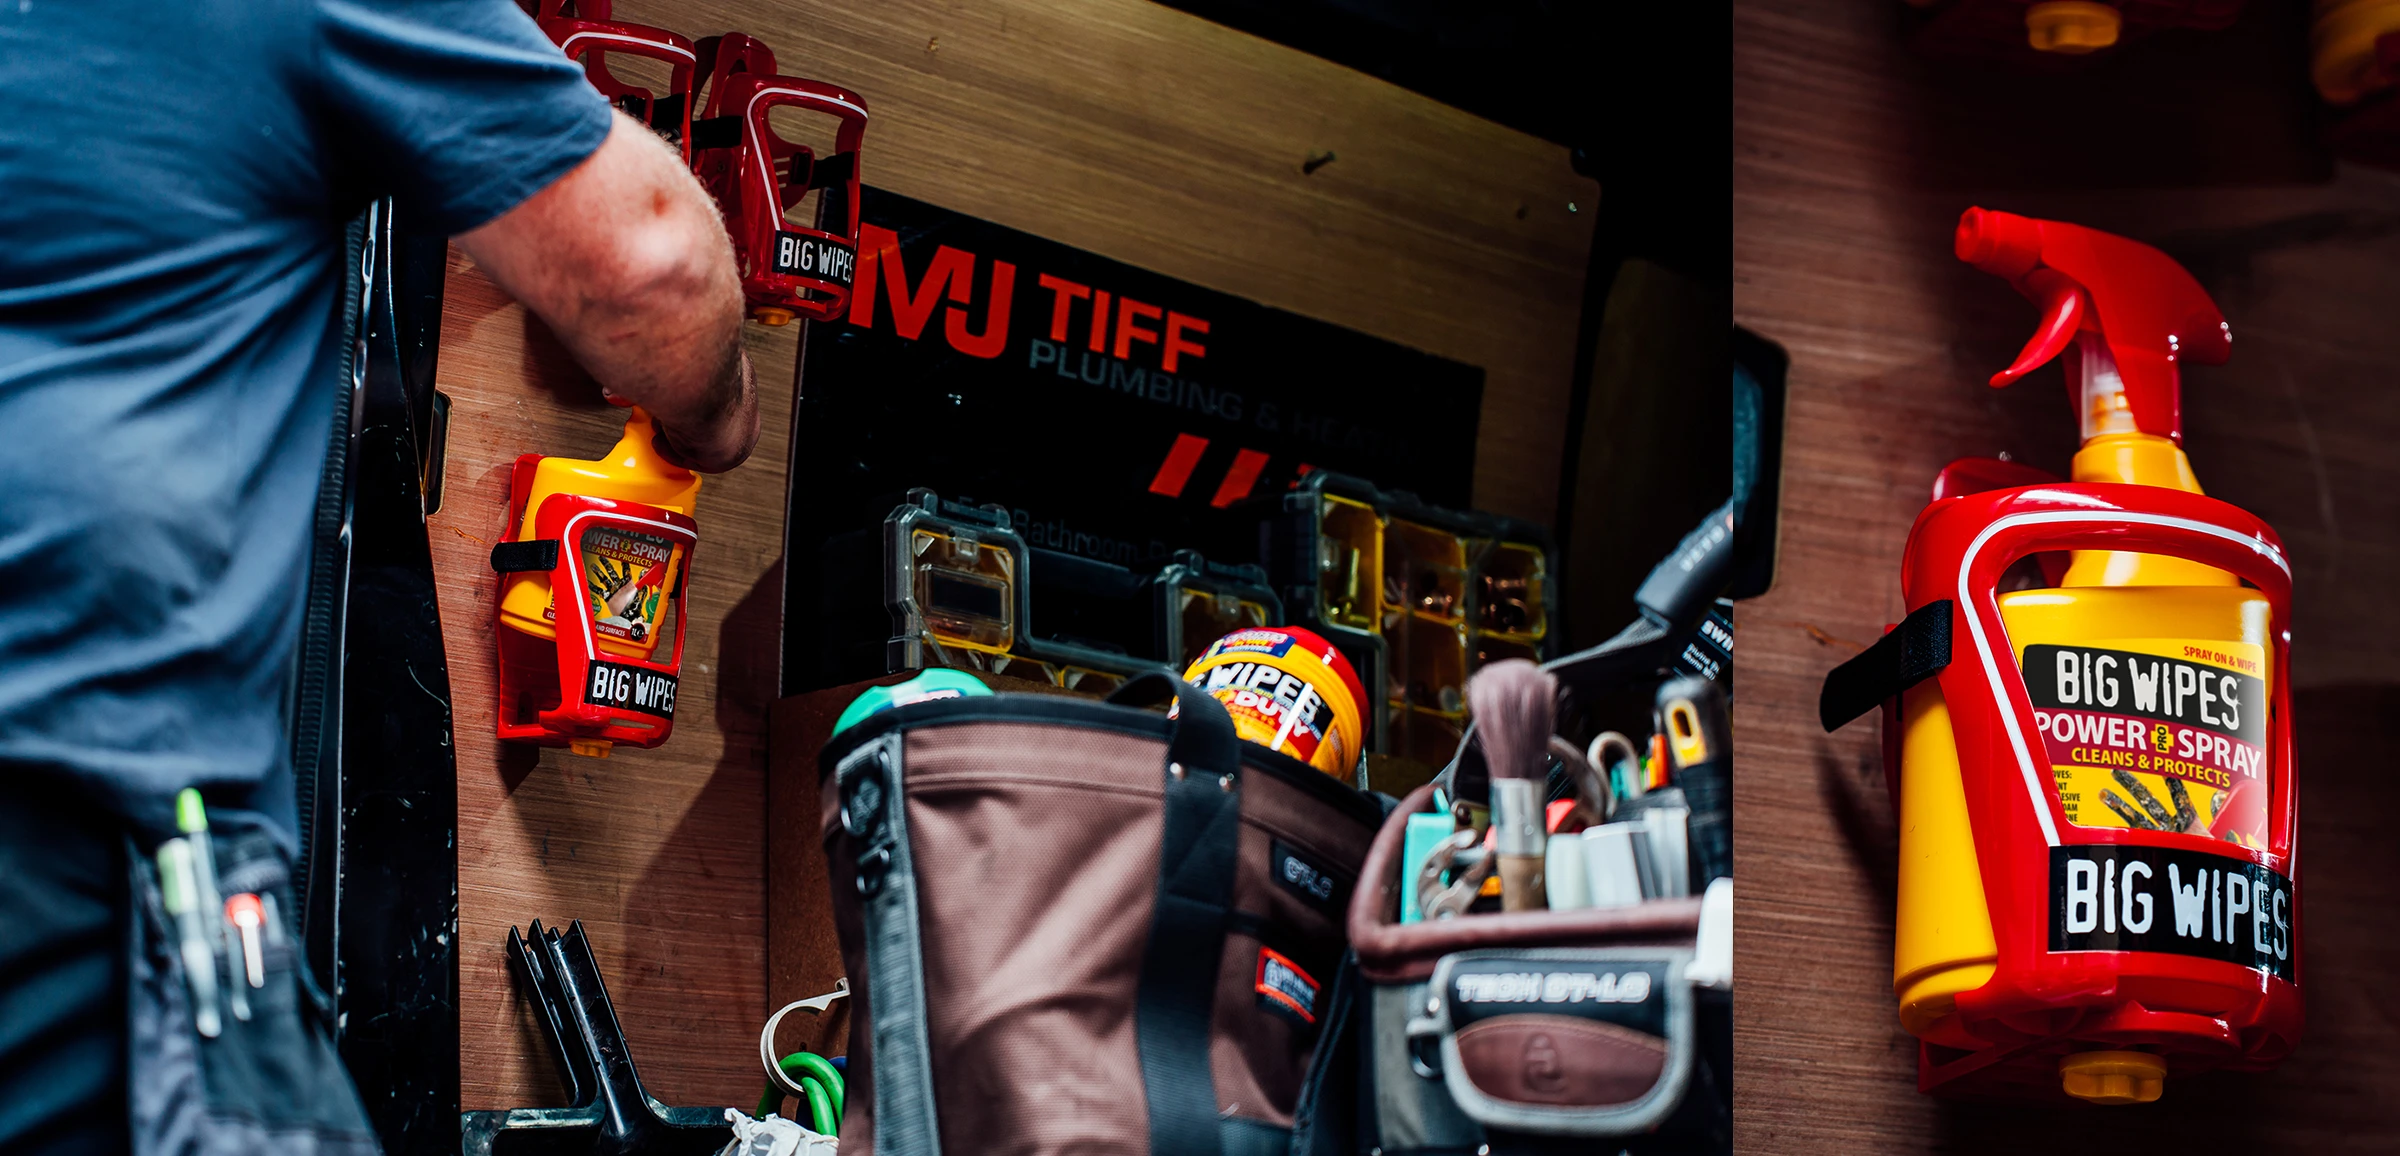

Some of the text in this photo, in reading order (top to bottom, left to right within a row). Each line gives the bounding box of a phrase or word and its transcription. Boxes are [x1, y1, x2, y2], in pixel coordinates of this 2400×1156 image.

[780, 236, 854, 284] BIG WIPES
[848, 222, 1211, 374] MJ TIFF
[1028, 337, 1244, 422] PLUMBING
[1253, 400, 1281, 432] &
[583, 543, 611, 557] CLEANS
[618, 552, 653, 567] PROTECTS
[631, 541, 671, 563] SPRAY
[1012, 507, 1135, 565] Bathroom
[2183, 645, 2257, 673] SPRAY ON & WIPE
[593, 665, 676, 713] BIG WIPES
[1206, 662, 1322, 722] WIPES
[2056, 650, 2240, 730] BIG WIPES
[1234, 690, 1309, 738] DUTY
[2034, 711, 2261, 779] POWER PRO SPRAY
[2071, 747, 2231, 788] CLEANS & PROTECTS
[2061, 793, 2081, 802] ESIVE
[2063, 803, 2078, 812] OAM
[2067, 858, 2288, 961] BIG WIPES
